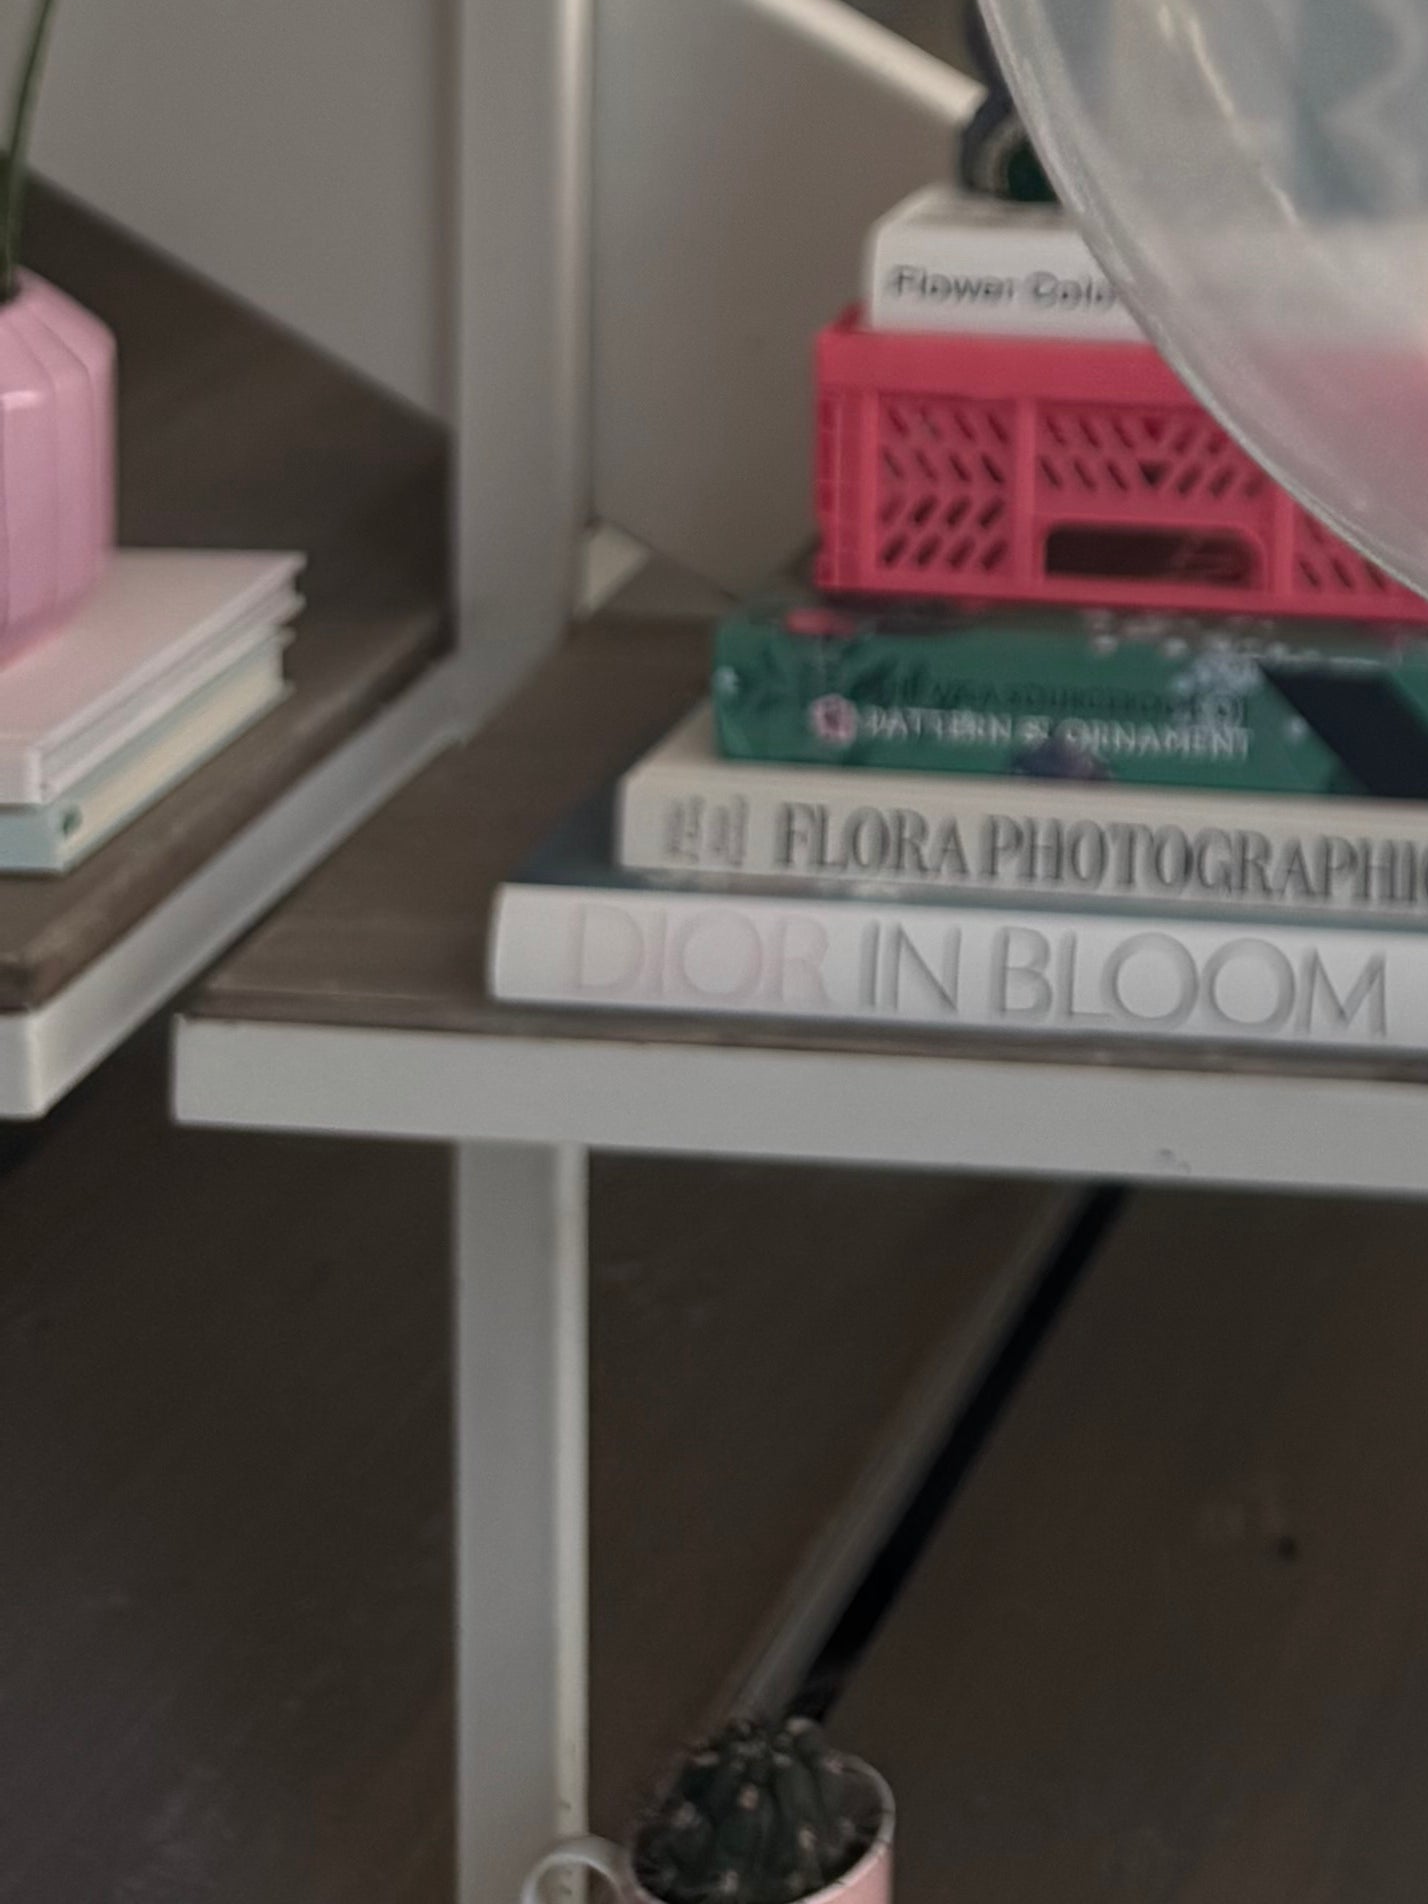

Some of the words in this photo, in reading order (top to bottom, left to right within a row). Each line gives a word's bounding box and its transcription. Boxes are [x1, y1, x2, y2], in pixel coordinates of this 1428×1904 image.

[889, 263, 1018, 305] Flower
[1024, 270, 1119, 311] Colo
[864, 705, 1012, 745] PATTERN
[1053, 716, 1252, 761] ORNAMENT
[775, 800, 972, 878] FLORA
[564, 902, 832, 1004] DIOR
[859, 917, 963, 1012] IN
[990, 925, 1390, 1038] BLOOM
